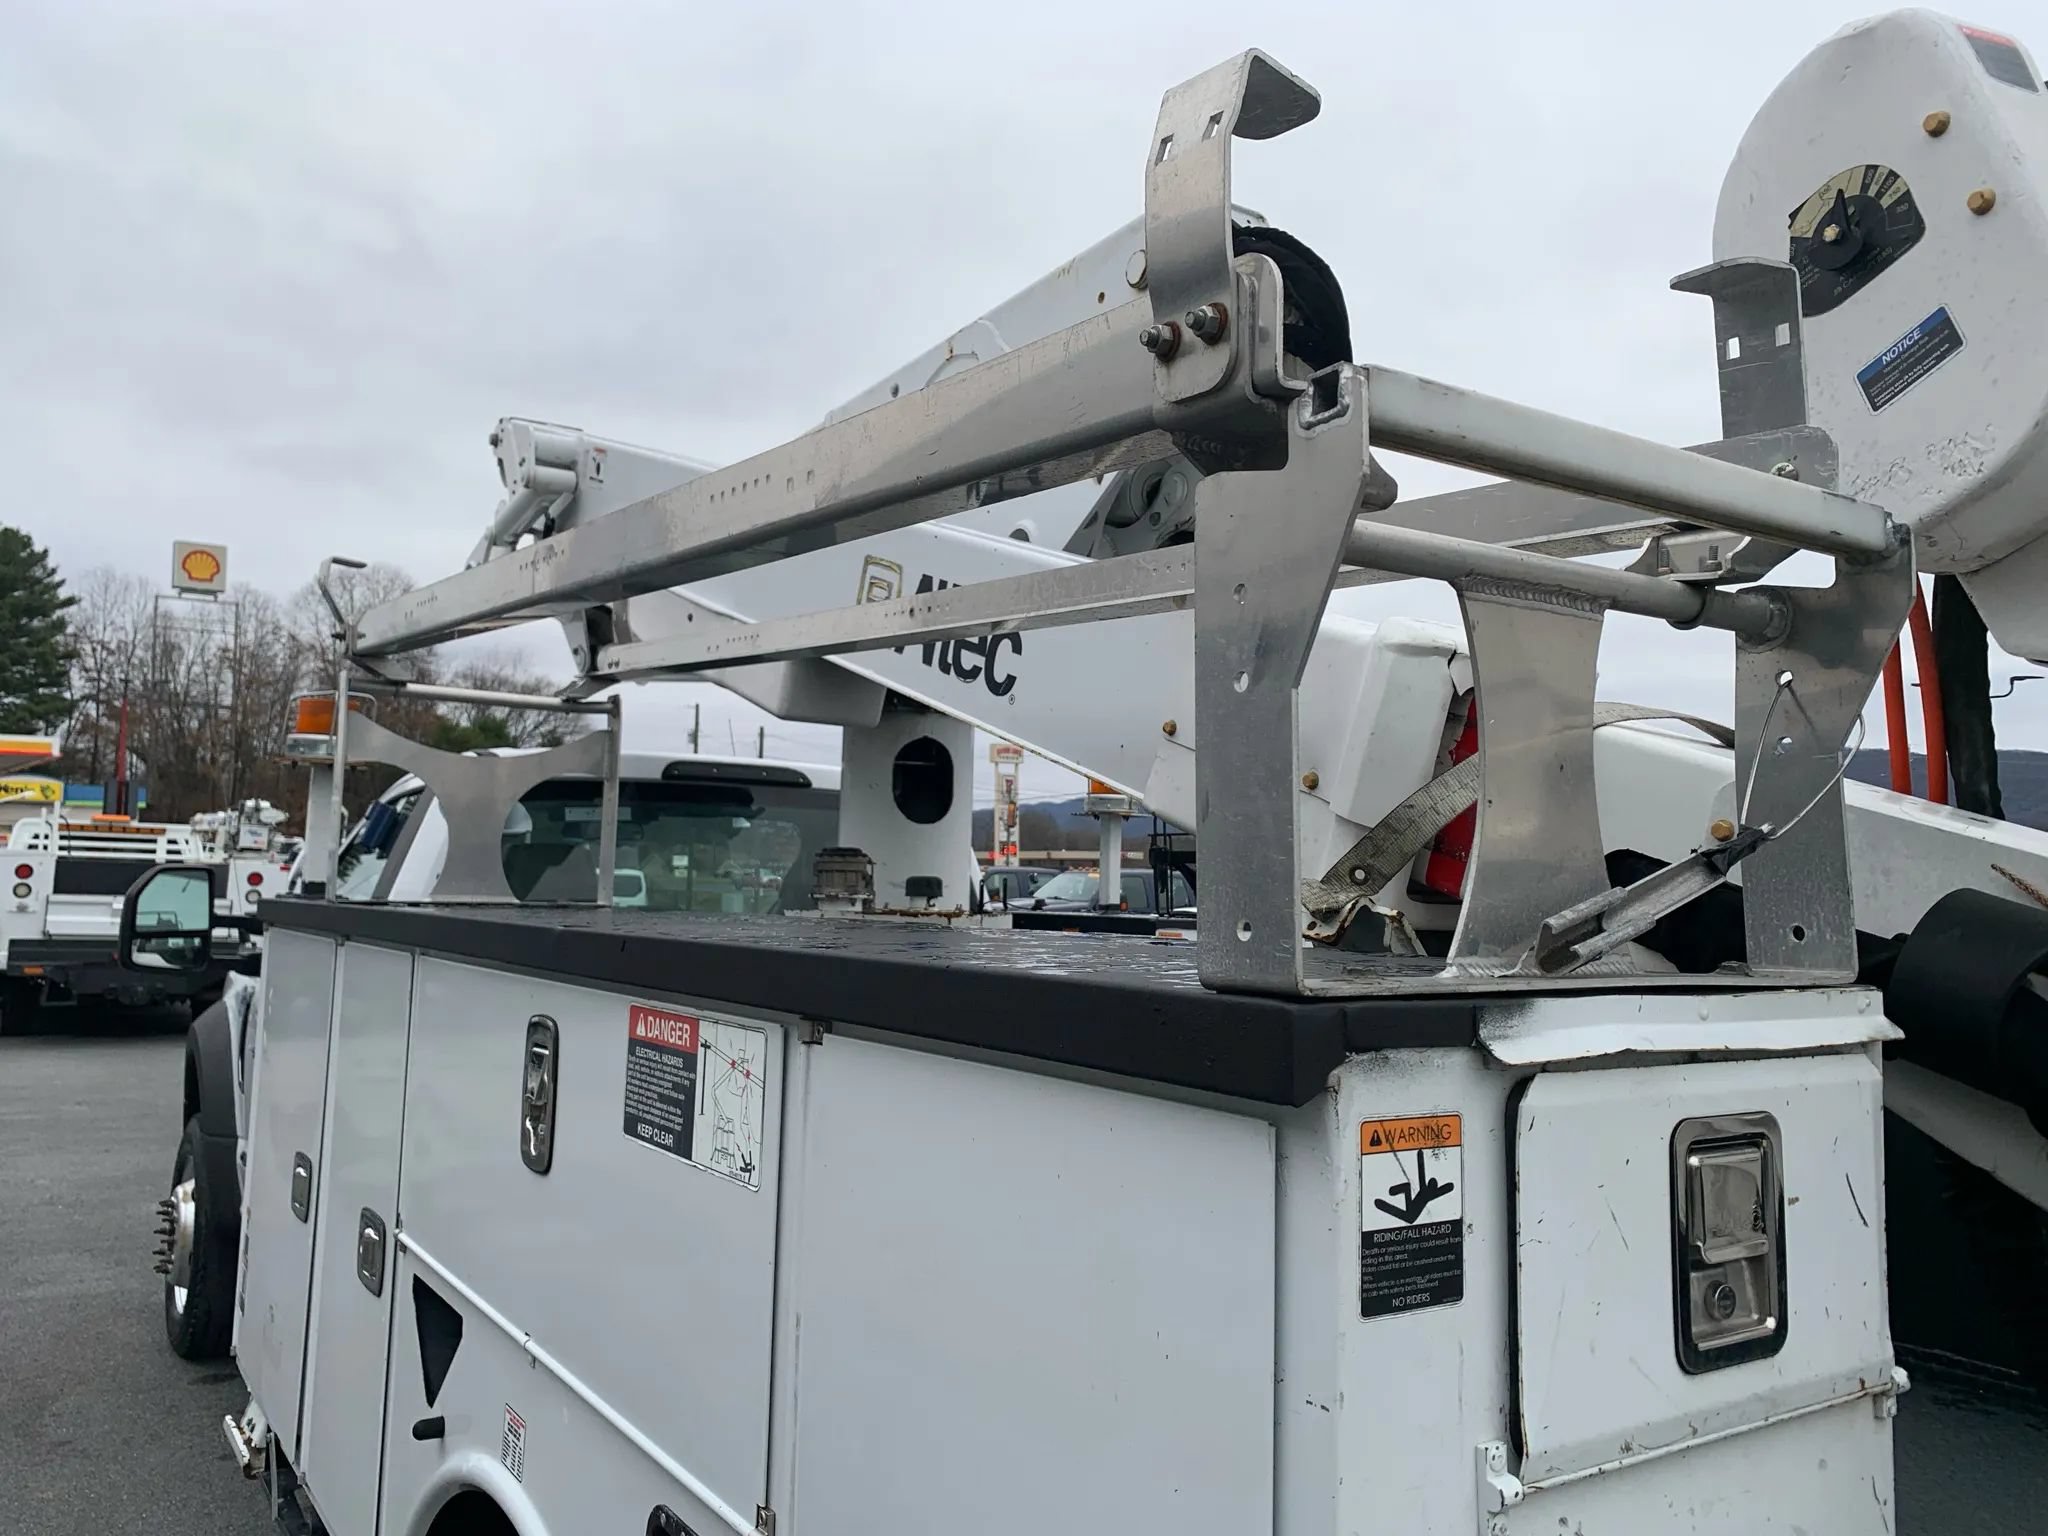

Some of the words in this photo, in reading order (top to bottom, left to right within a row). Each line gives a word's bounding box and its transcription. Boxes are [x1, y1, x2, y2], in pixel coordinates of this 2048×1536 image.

[1882, 327, 1922, 365] NOTICE
[647, 1016, 690, 1047] DANGER
[636, 1046, 661, 1062] ELECTRICAL
[661, 1053, 684, 1068] HAZARDS
[637, 1122, 653, 1139] KEEP
[653, 1128, 674, 1147] CLEAR
[1383, 1123, 1452, 1144] WARNING
[1374, 1228, 1420, 1242] RIDING/FALL
[1422, 1224, 1451, 1236] HAZARD
[1420, 1240, 1435, 1248] could
[1392, 1297, 1405, 1307] NO
[1406, 1293, 1430, 1305] RIDERS
